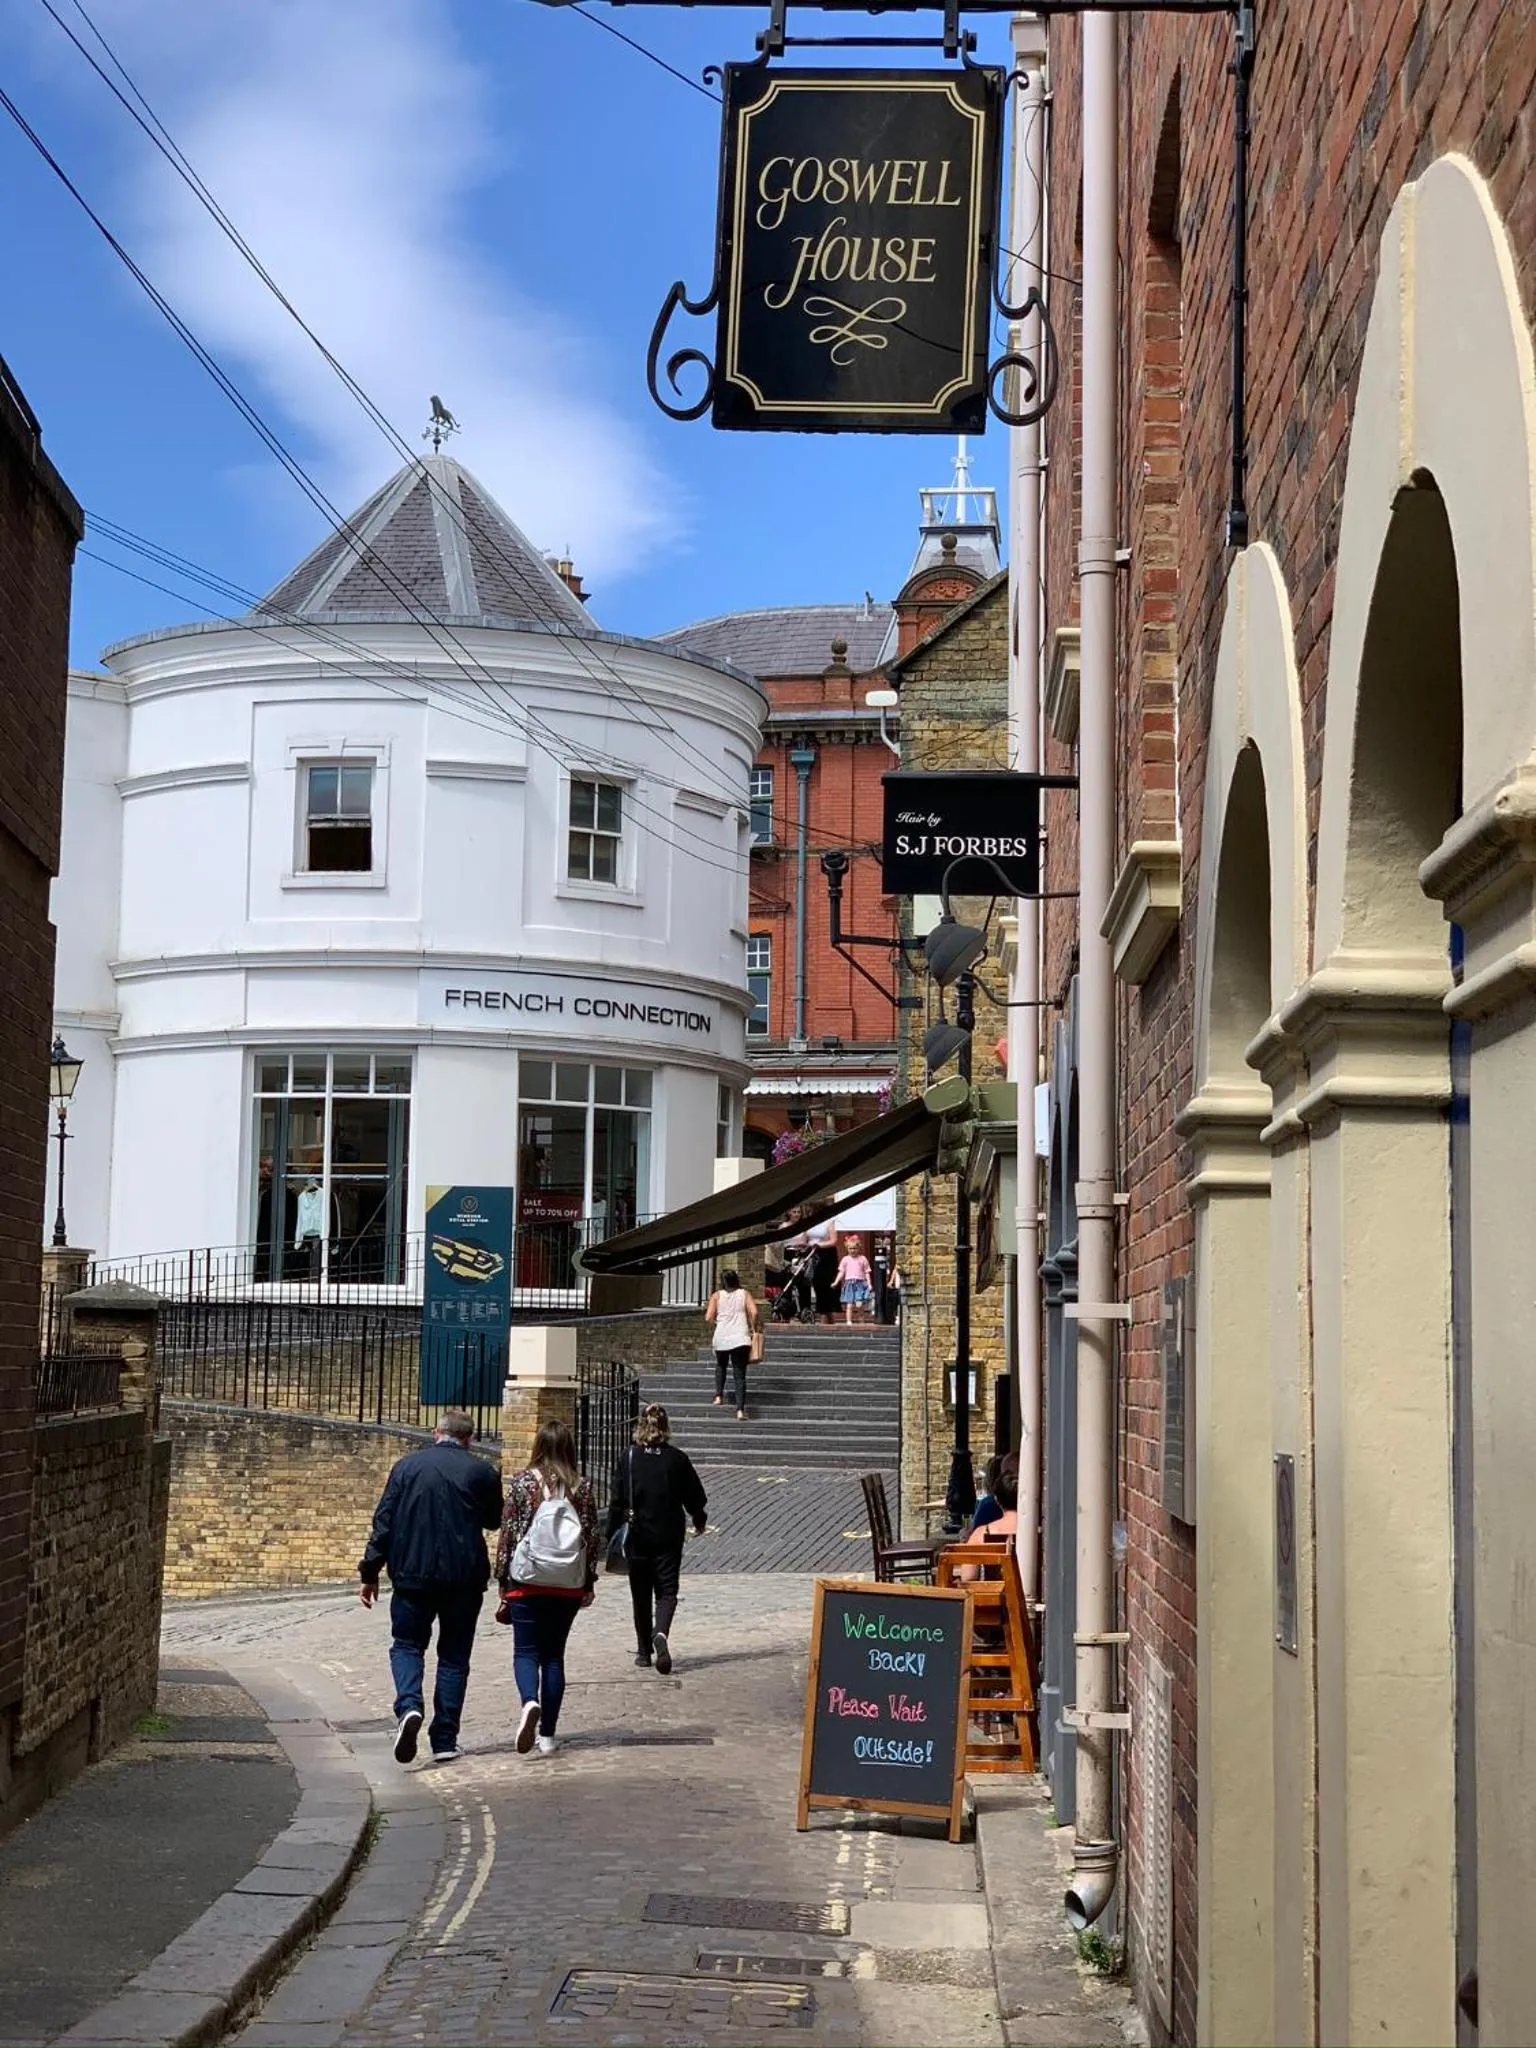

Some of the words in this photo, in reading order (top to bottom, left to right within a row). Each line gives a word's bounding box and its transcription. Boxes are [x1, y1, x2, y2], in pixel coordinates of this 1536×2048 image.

[756, 157, 961, 230] GOSWELL
[764, 216, 936, 309] HOUSE
[895, 812, 925, 823] Hair
[926, 813, 942, 827] by
[895, 835, 928, 855] S.J
[933, 836, 1027, 857] FORBES
[445, 989, 563, 1013] FRENCH
[574, 998, 711, 1033] CONNECTION
[535, 1208, 546, 1216] TO
[563, 1209, 579, 1218] OFF
[843, 1612, 944, 1642] Welcome
[828, 1687, 879, 1718] Please
[888, 1694, 928, 1722] Wait
